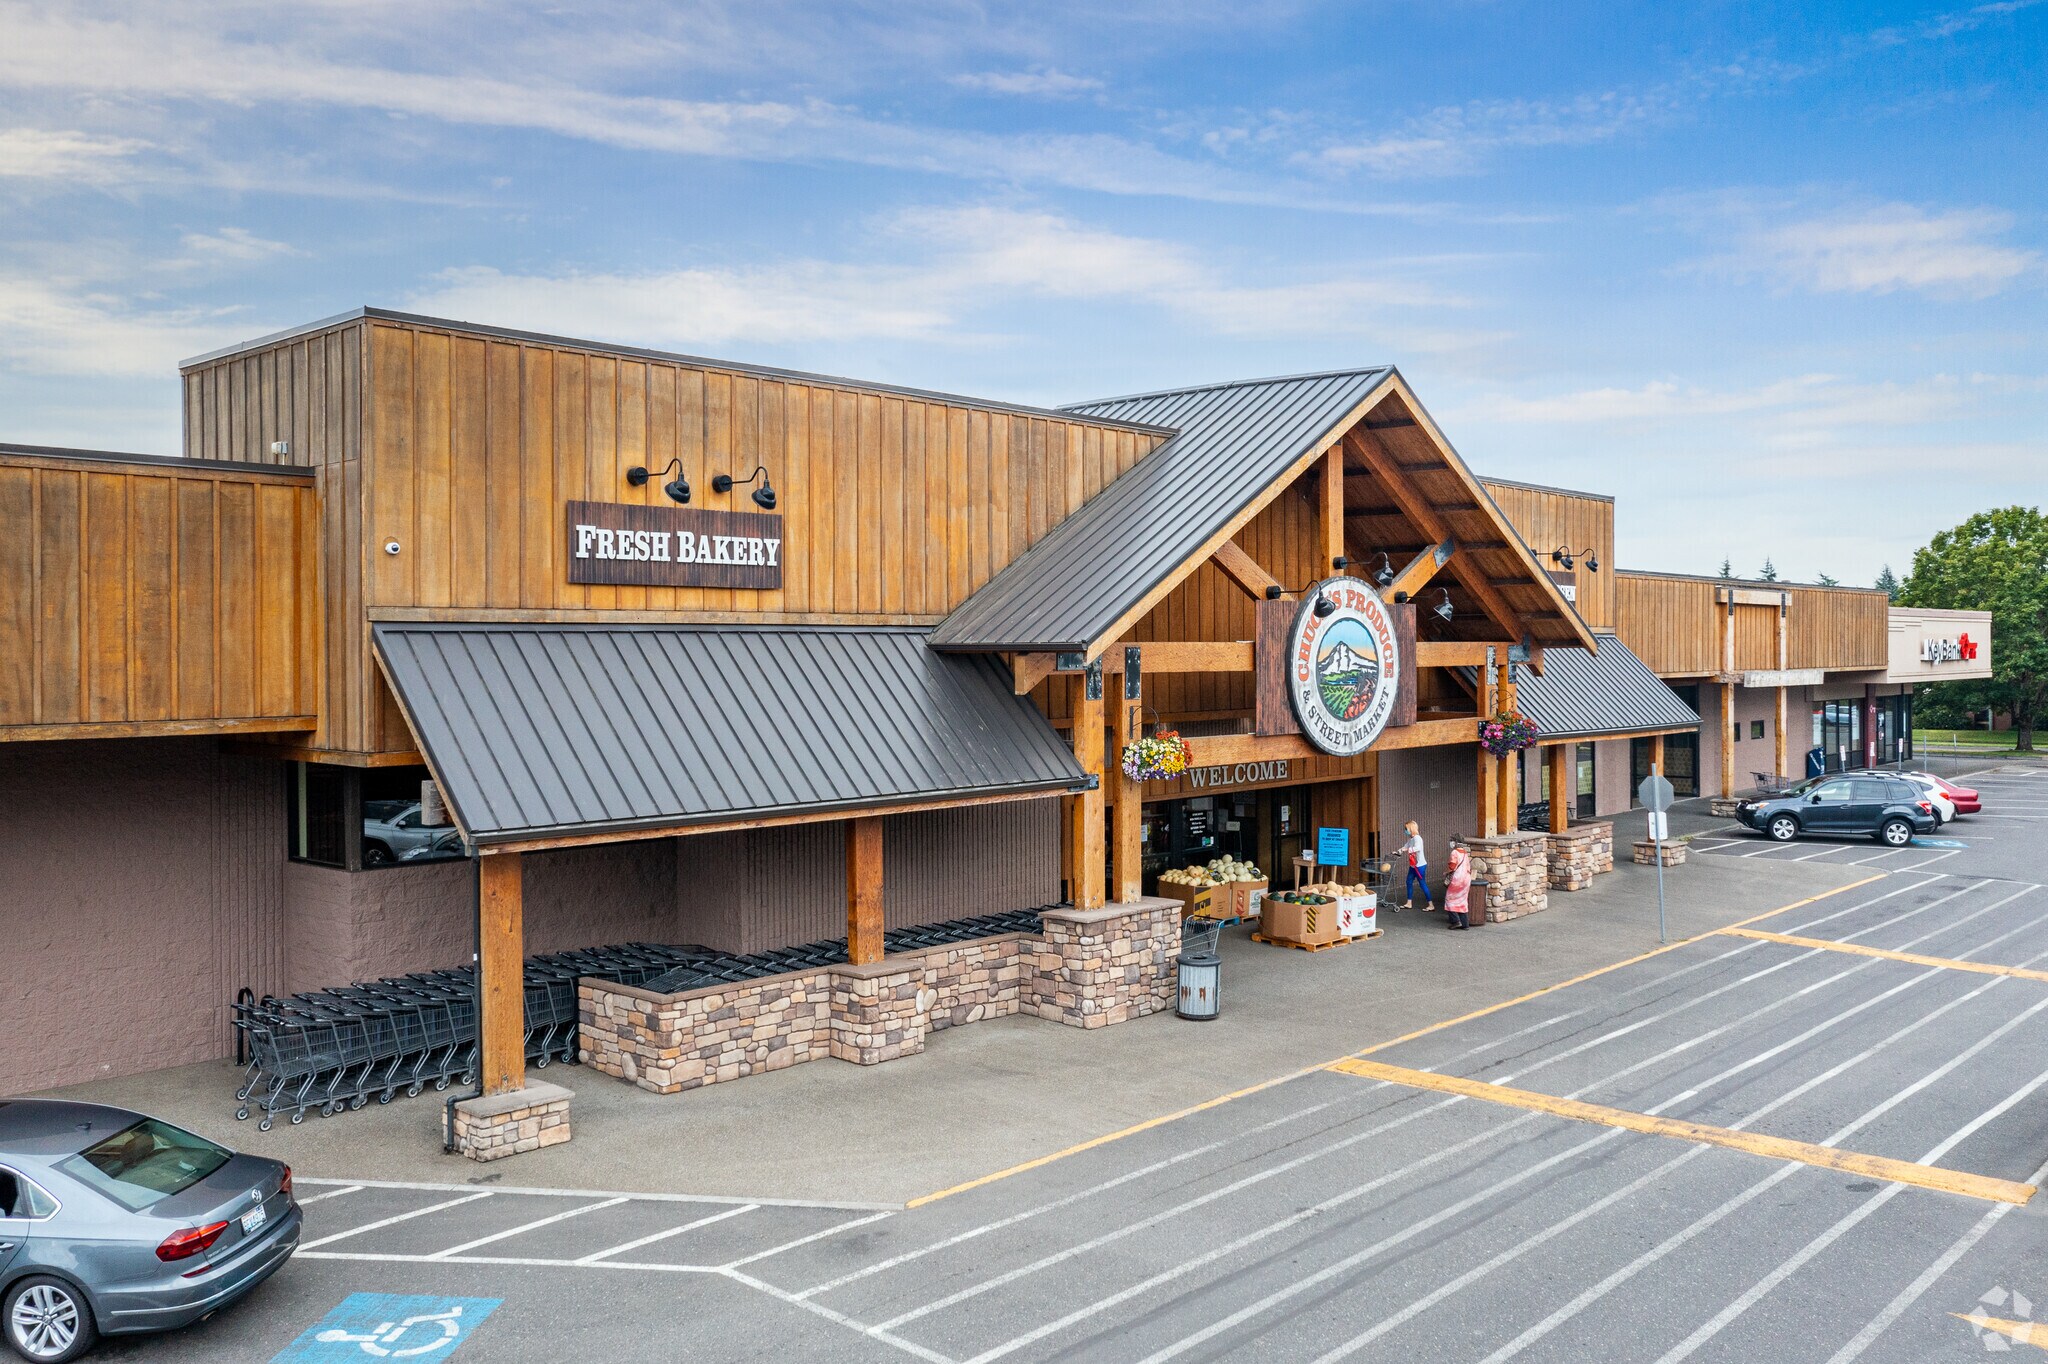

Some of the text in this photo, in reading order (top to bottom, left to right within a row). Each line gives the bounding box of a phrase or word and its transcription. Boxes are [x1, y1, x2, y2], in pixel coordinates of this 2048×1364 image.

[575, 524, 781, 567] FRESH BAKERY
[1298, 589, 1395, 682] CHUC'S PRODUCE
[1302, 686, 1392, 746] & STREET MARKET
[1189, 760, 1288, 788] WELCOME
